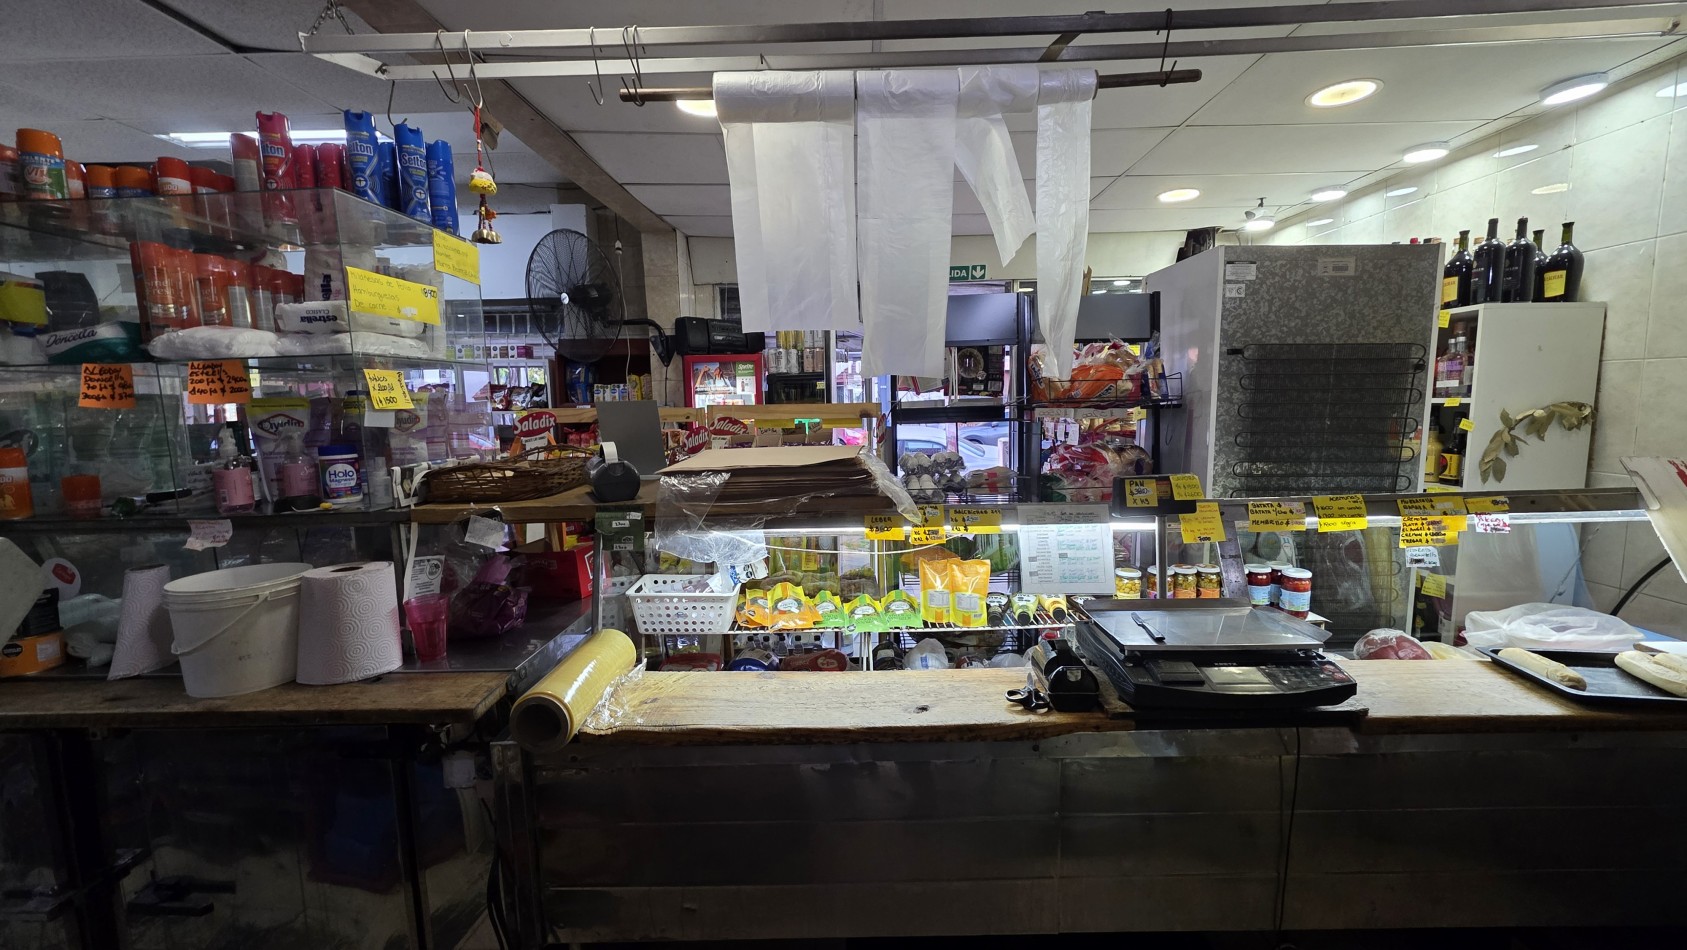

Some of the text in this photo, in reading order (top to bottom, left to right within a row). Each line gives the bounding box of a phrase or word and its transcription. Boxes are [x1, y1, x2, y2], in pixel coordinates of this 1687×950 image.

[949, 269, 967, 277] IDA
[300, 315, 338, 324] estrella
[514, 415, 556, 435] Saladix
[709, 415, 747, 435] Saladix
[684, 429, 709, 451] Saladix
[328, 469, 355, 479] Holo
